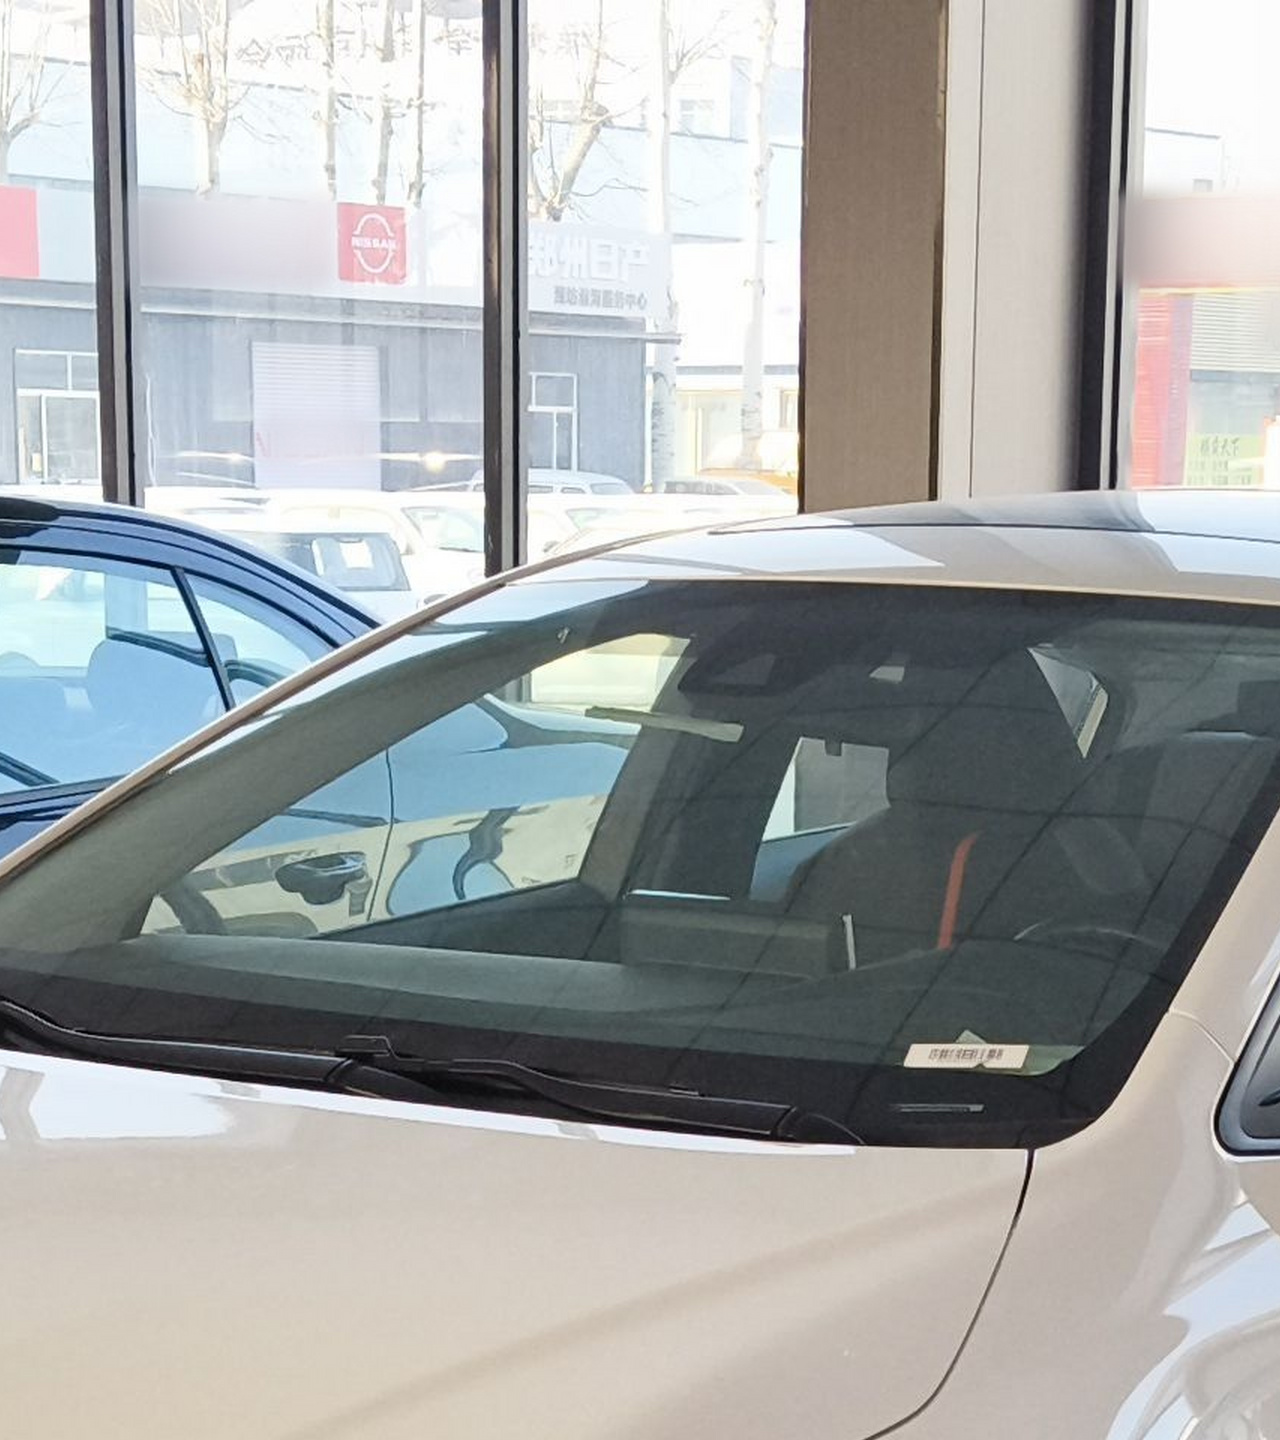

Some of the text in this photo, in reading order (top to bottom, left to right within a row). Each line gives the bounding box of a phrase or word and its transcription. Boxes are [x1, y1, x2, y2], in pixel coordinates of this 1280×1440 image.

[351, 236, 397, 250] NISSAN
[529, 231, 650, 282] 郑州日产
